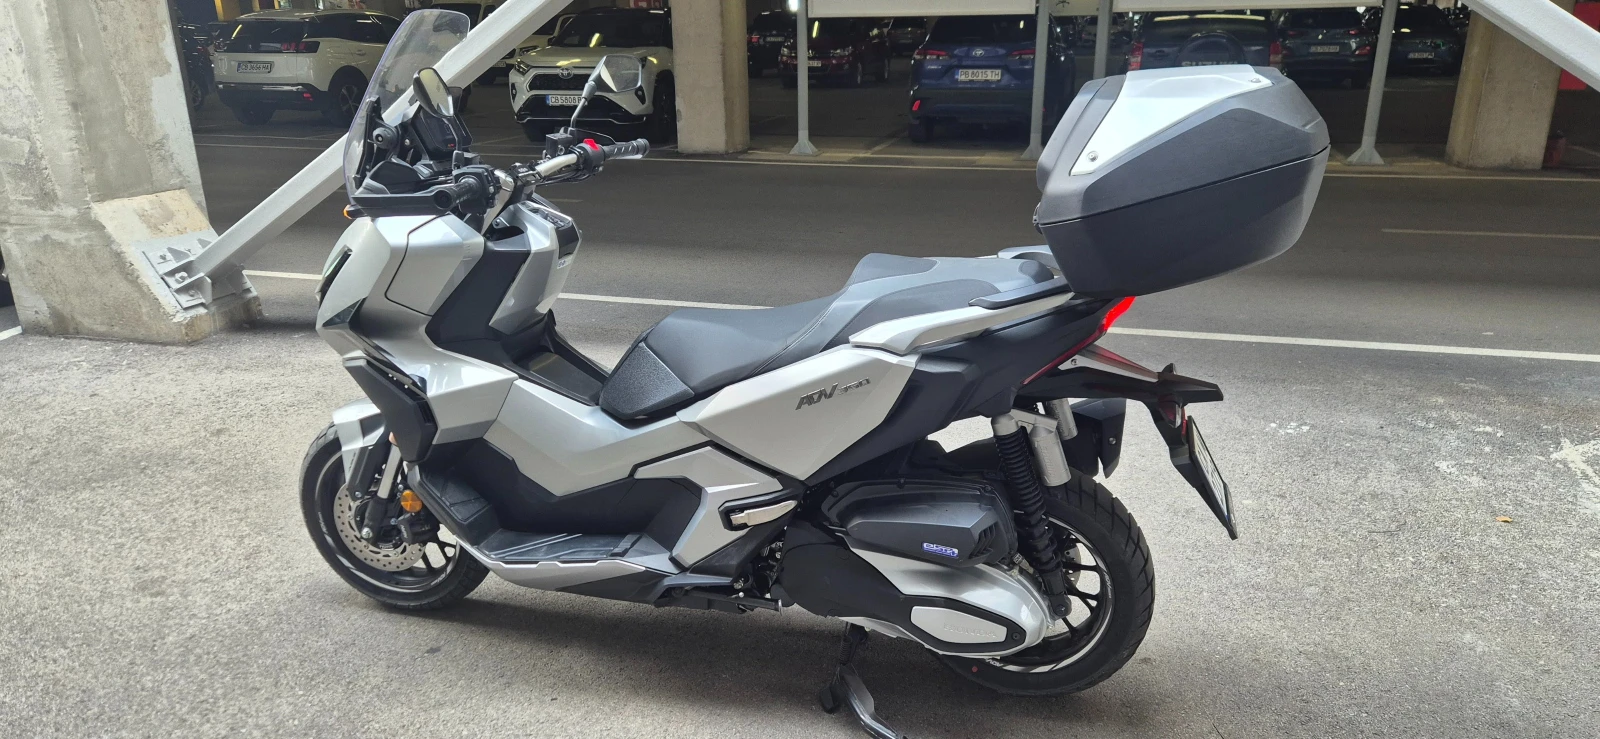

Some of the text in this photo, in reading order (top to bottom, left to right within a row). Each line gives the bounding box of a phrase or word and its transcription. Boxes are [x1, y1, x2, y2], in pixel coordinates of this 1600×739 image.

[959, 70, 1001, 79] PB 8015 TH
[550, 96, 560, 104] CB
[560, 96, 577, 104] 5808
[795, 382, 839, 411] ADV
